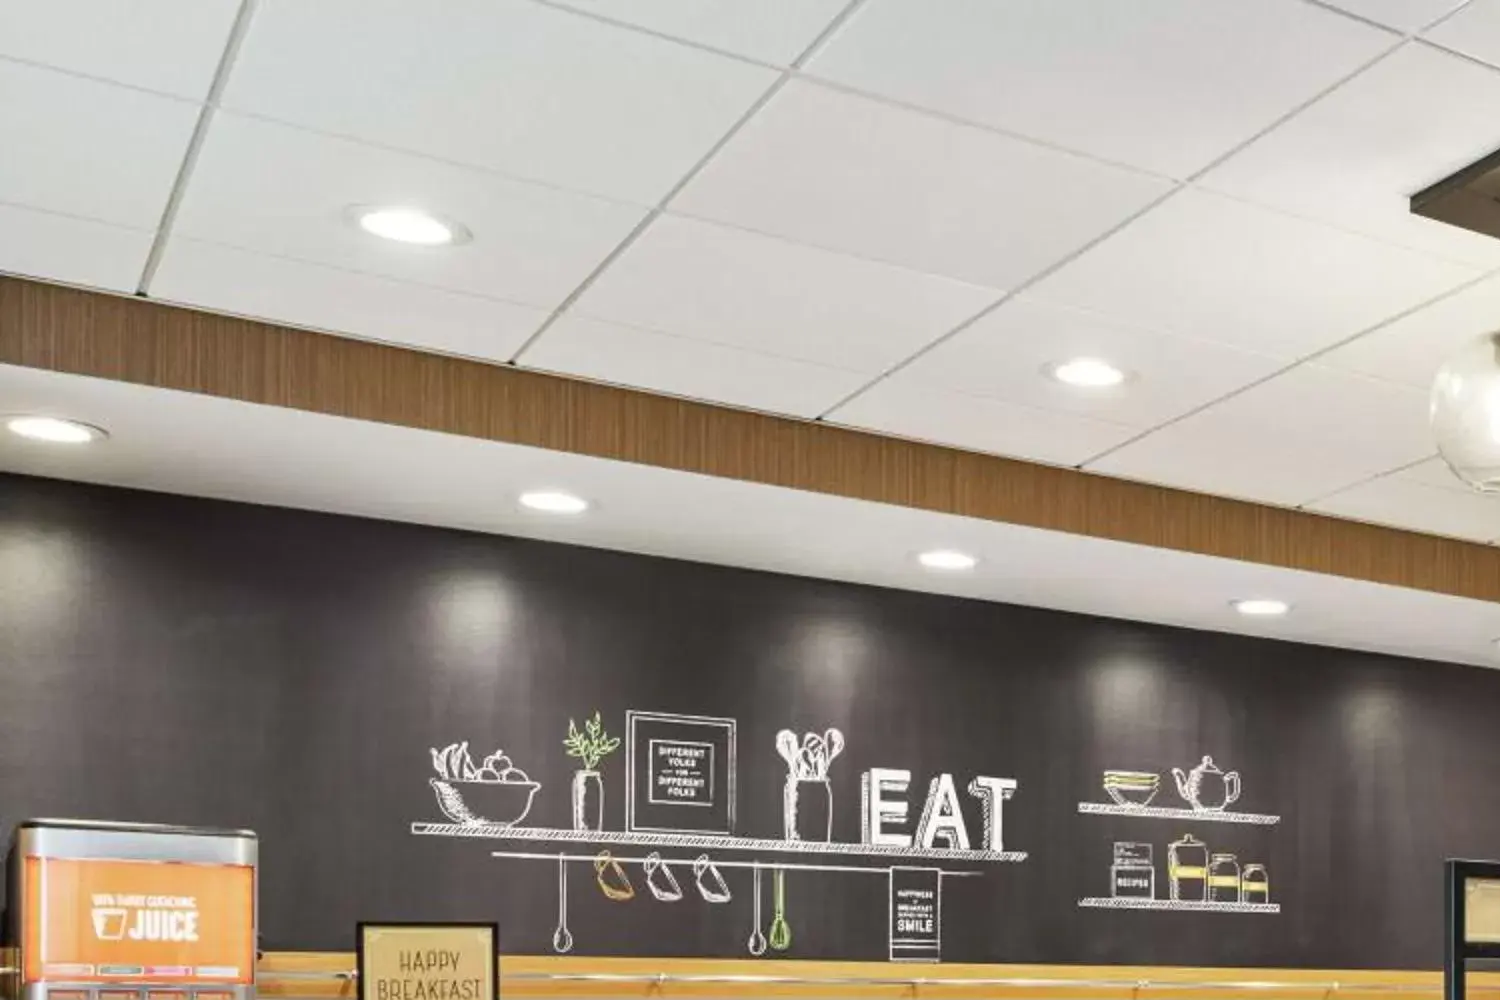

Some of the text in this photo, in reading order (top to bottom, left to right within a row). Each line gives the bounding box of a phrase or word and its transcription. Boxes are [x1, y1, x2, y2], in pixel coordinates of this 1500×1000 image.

[861, 767, 1018, 852] EAT
[127, 909, 200, 942] JUICE
[897, 919, 934, 933] SMILE
[399, 950, 460, 973] HAPPY
